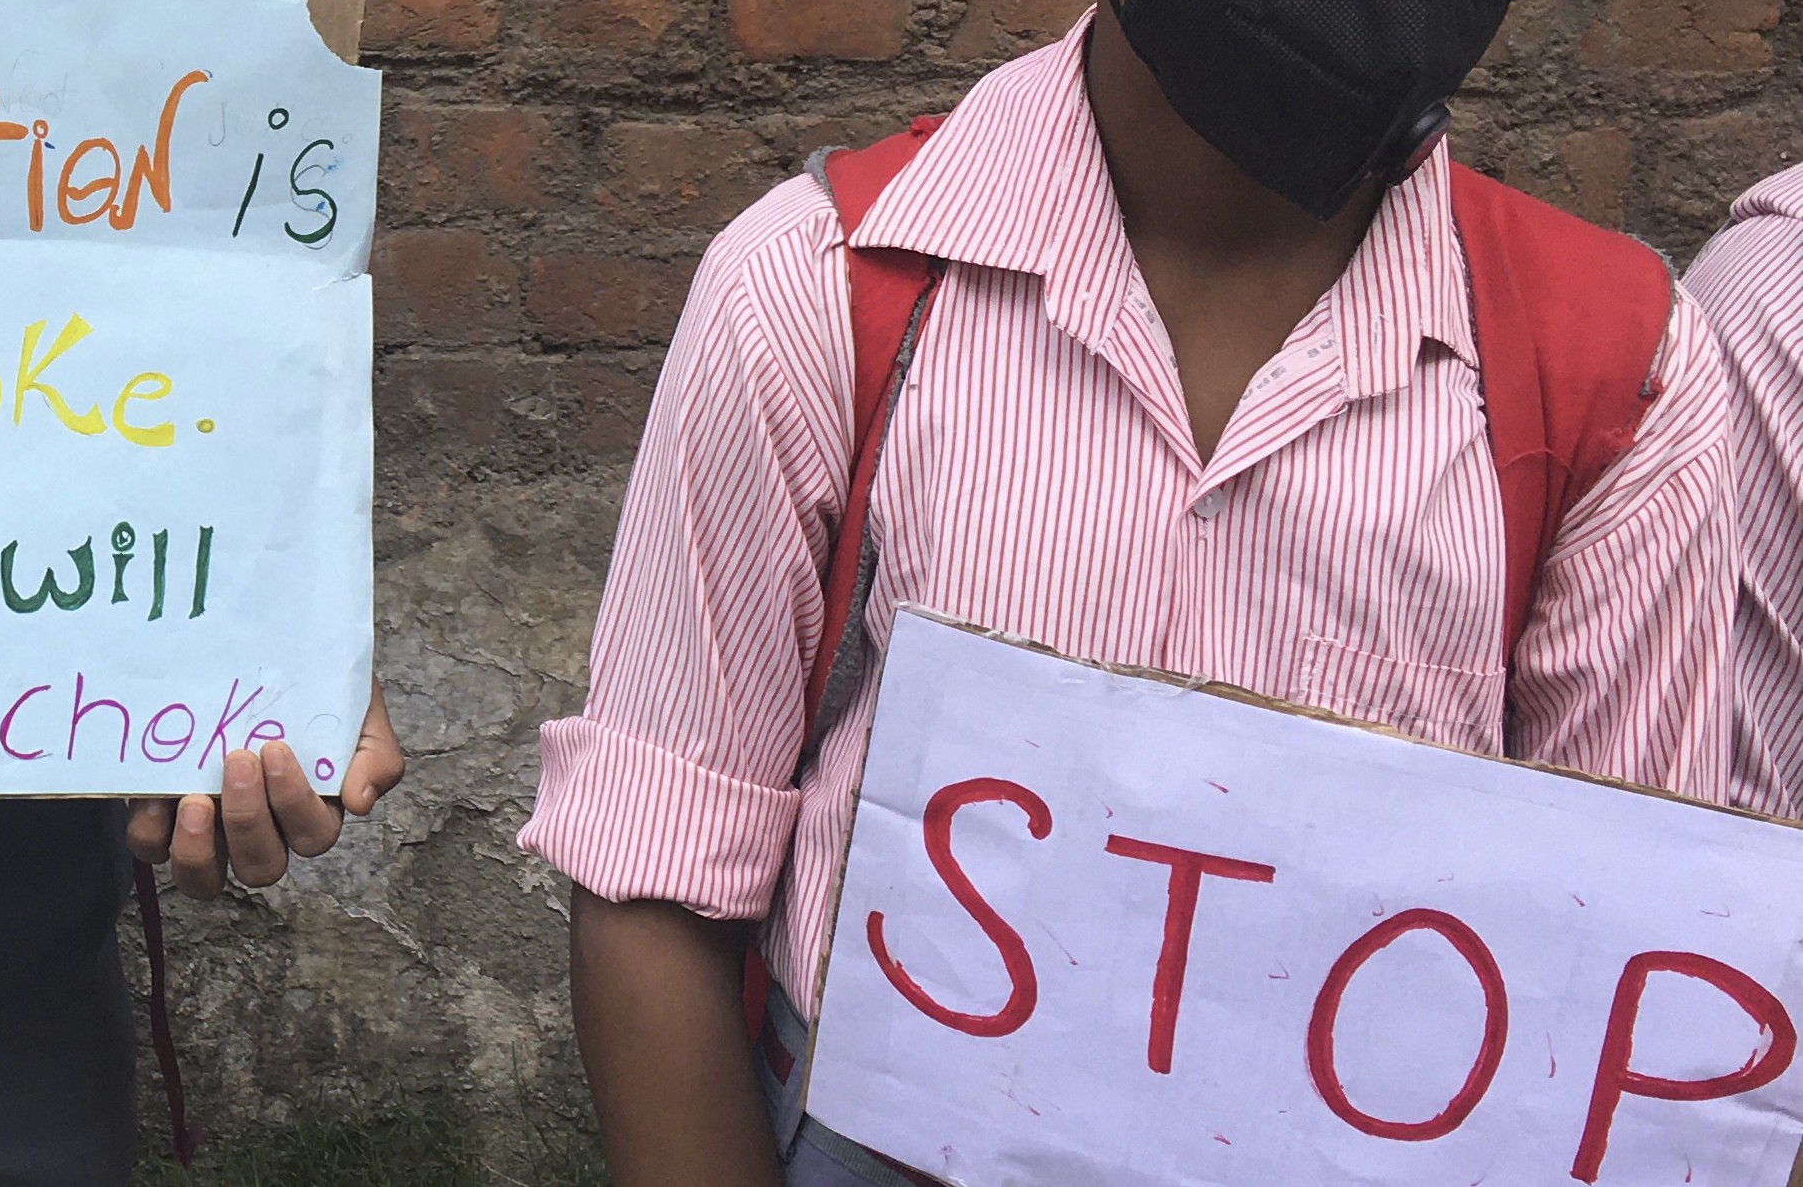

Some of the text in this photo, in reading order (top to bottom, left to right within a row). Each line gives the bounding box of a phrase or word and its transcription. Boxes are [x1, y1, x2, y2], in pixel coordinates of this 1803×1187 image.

[232, 107, 338, 244] is
[0, 521, 215, 622] will
[866, 777, 1798, 1185] STOP
